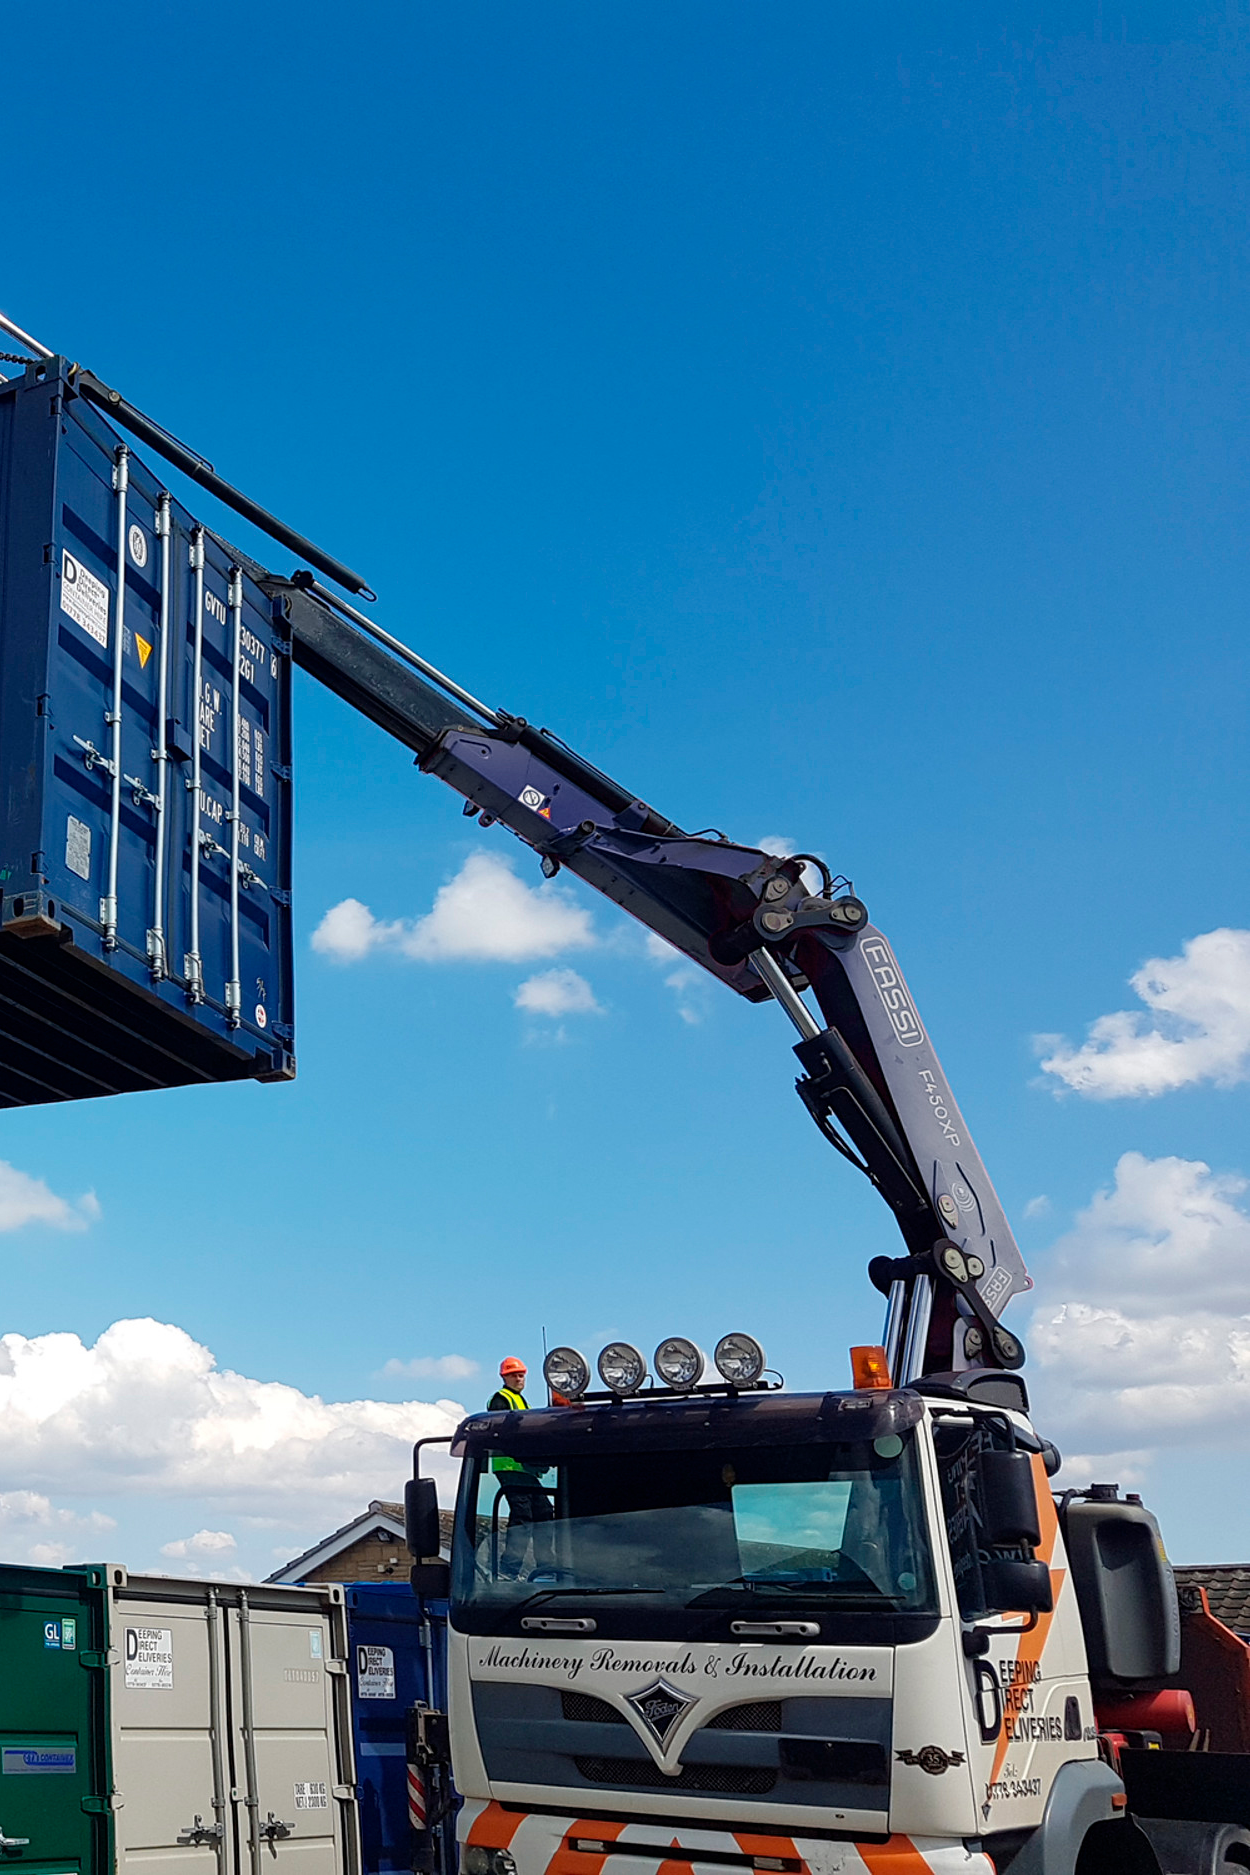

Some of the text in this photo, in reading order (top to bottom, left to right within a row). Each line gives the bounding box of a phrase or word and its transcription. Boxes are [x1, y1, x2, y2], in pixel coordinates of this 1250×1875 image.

[64, 553, 77, 584] D
[205, 591, 226, 626] GVTU
[240, 626, 265, 665] 30377
[239, 654, 254, 684] 2G1
[199, 701, 215, 732] ARE
[199, 789, 223, 826] U.CAP.
[865, 944, 918, 1039] FASSI
[918, 1070, 961, 1147] F450XP
[44, 1623, 60, 1640] GL
[479, 1645, 877, 1681] Machinery Removals & Installation
